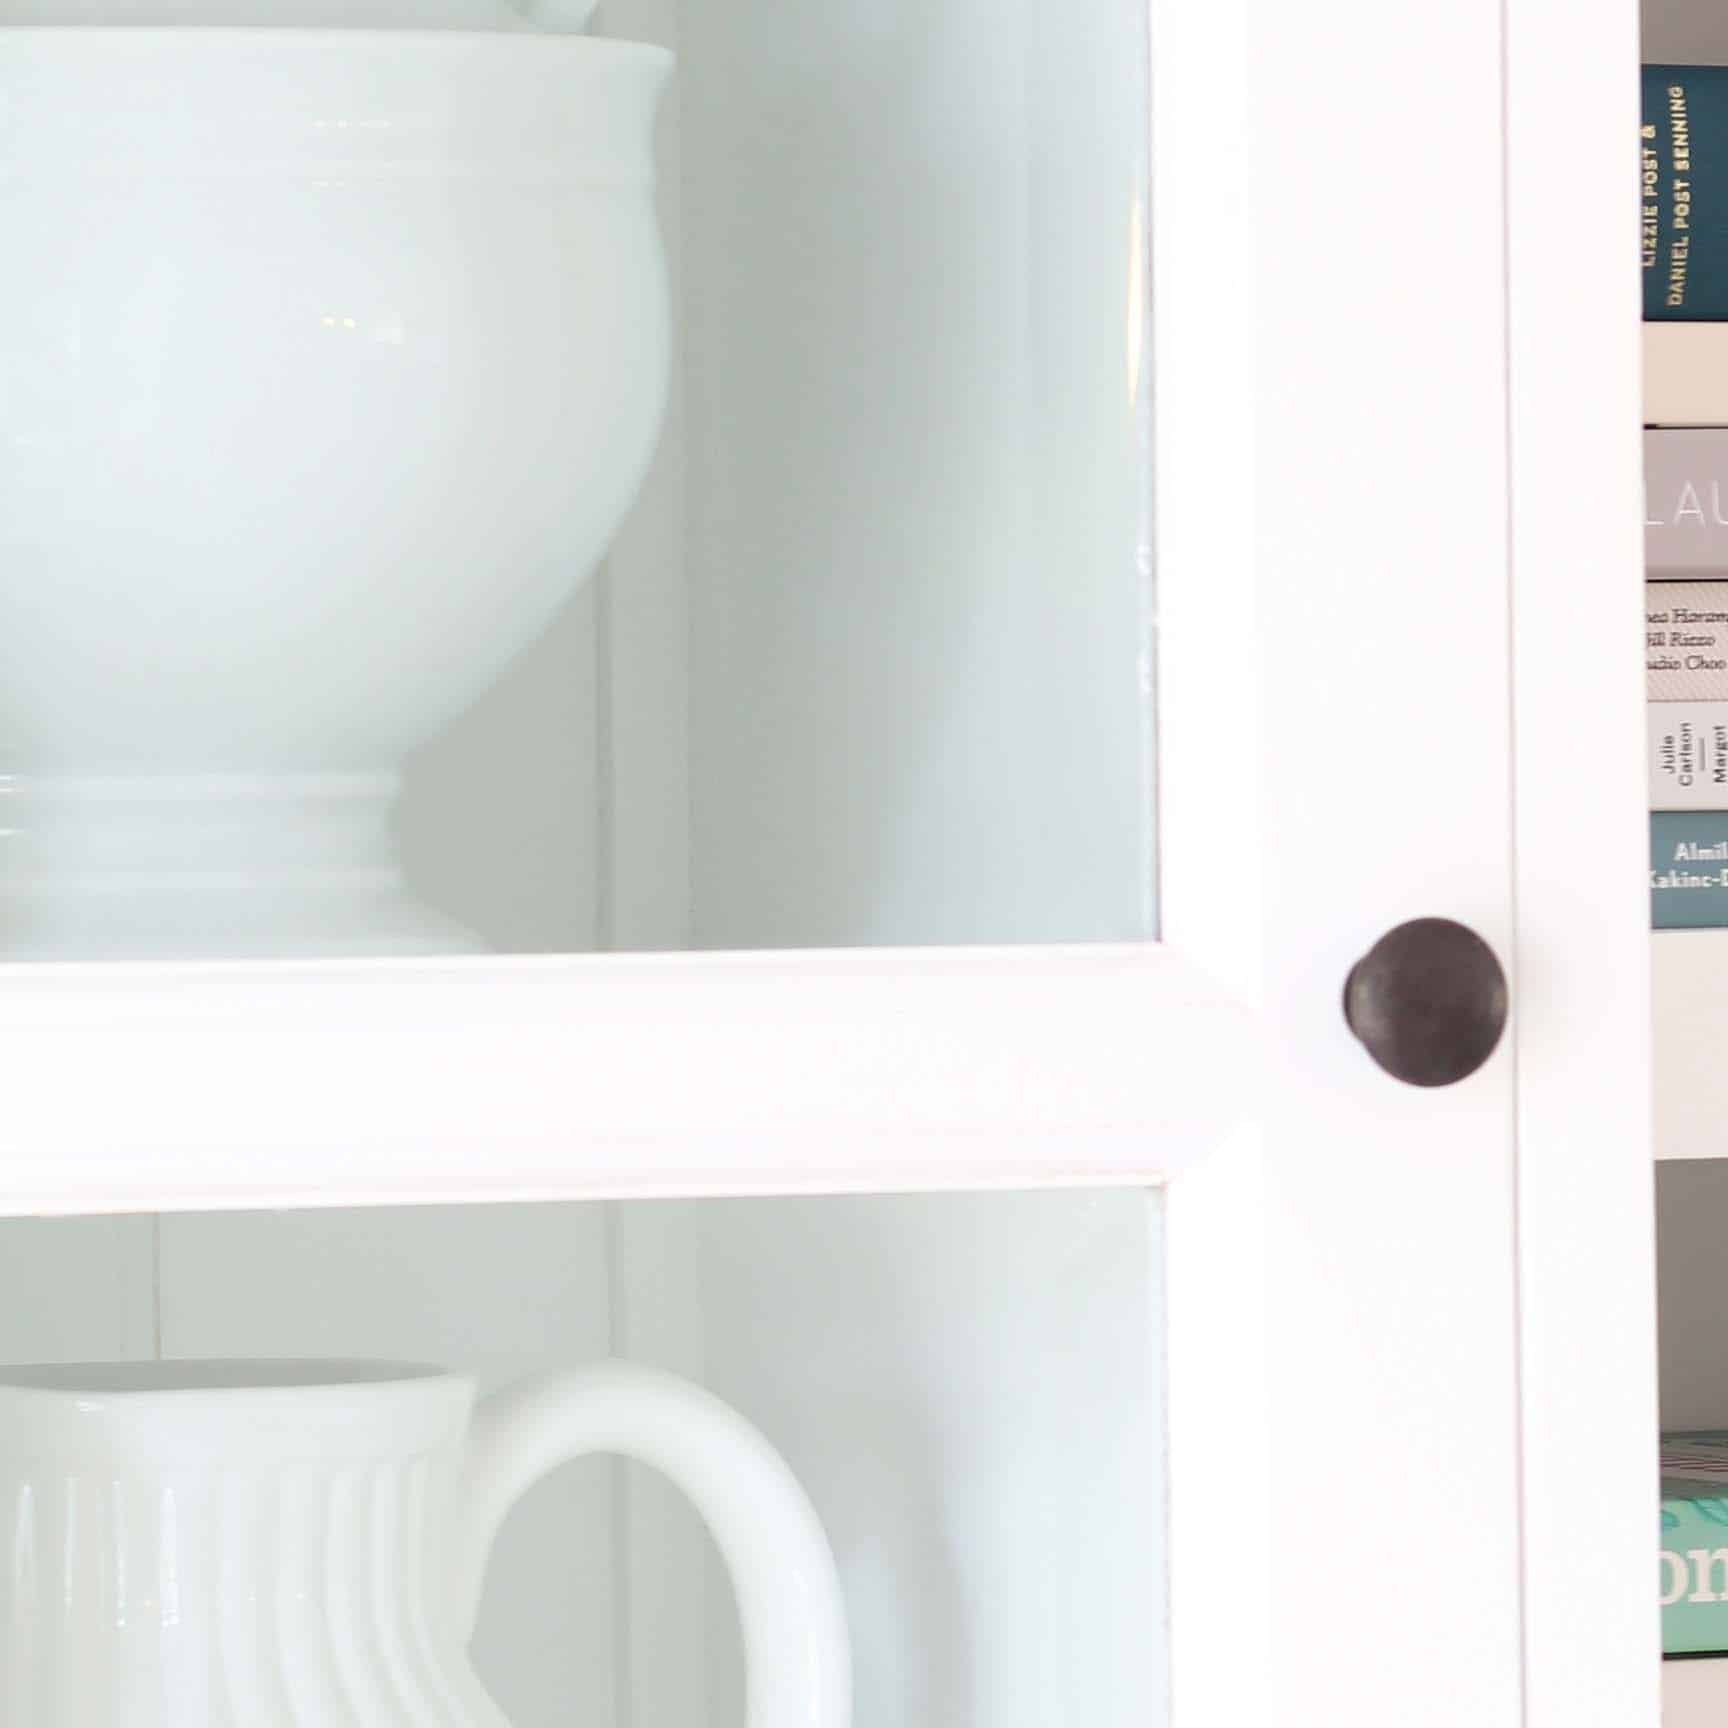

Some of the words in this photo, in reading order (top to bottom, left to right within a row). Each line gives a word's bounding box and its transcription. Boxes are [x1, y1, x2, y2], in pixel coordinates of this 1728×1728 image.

[1669, 85, 1690, 170] SENNING
[1673, 180, 1690, 229] POST
[1667, 237, 1689, 306] DANIEL
[1678, 722, 1692, 787] Carlson
[1713, 726, 1728, 783] Margot
